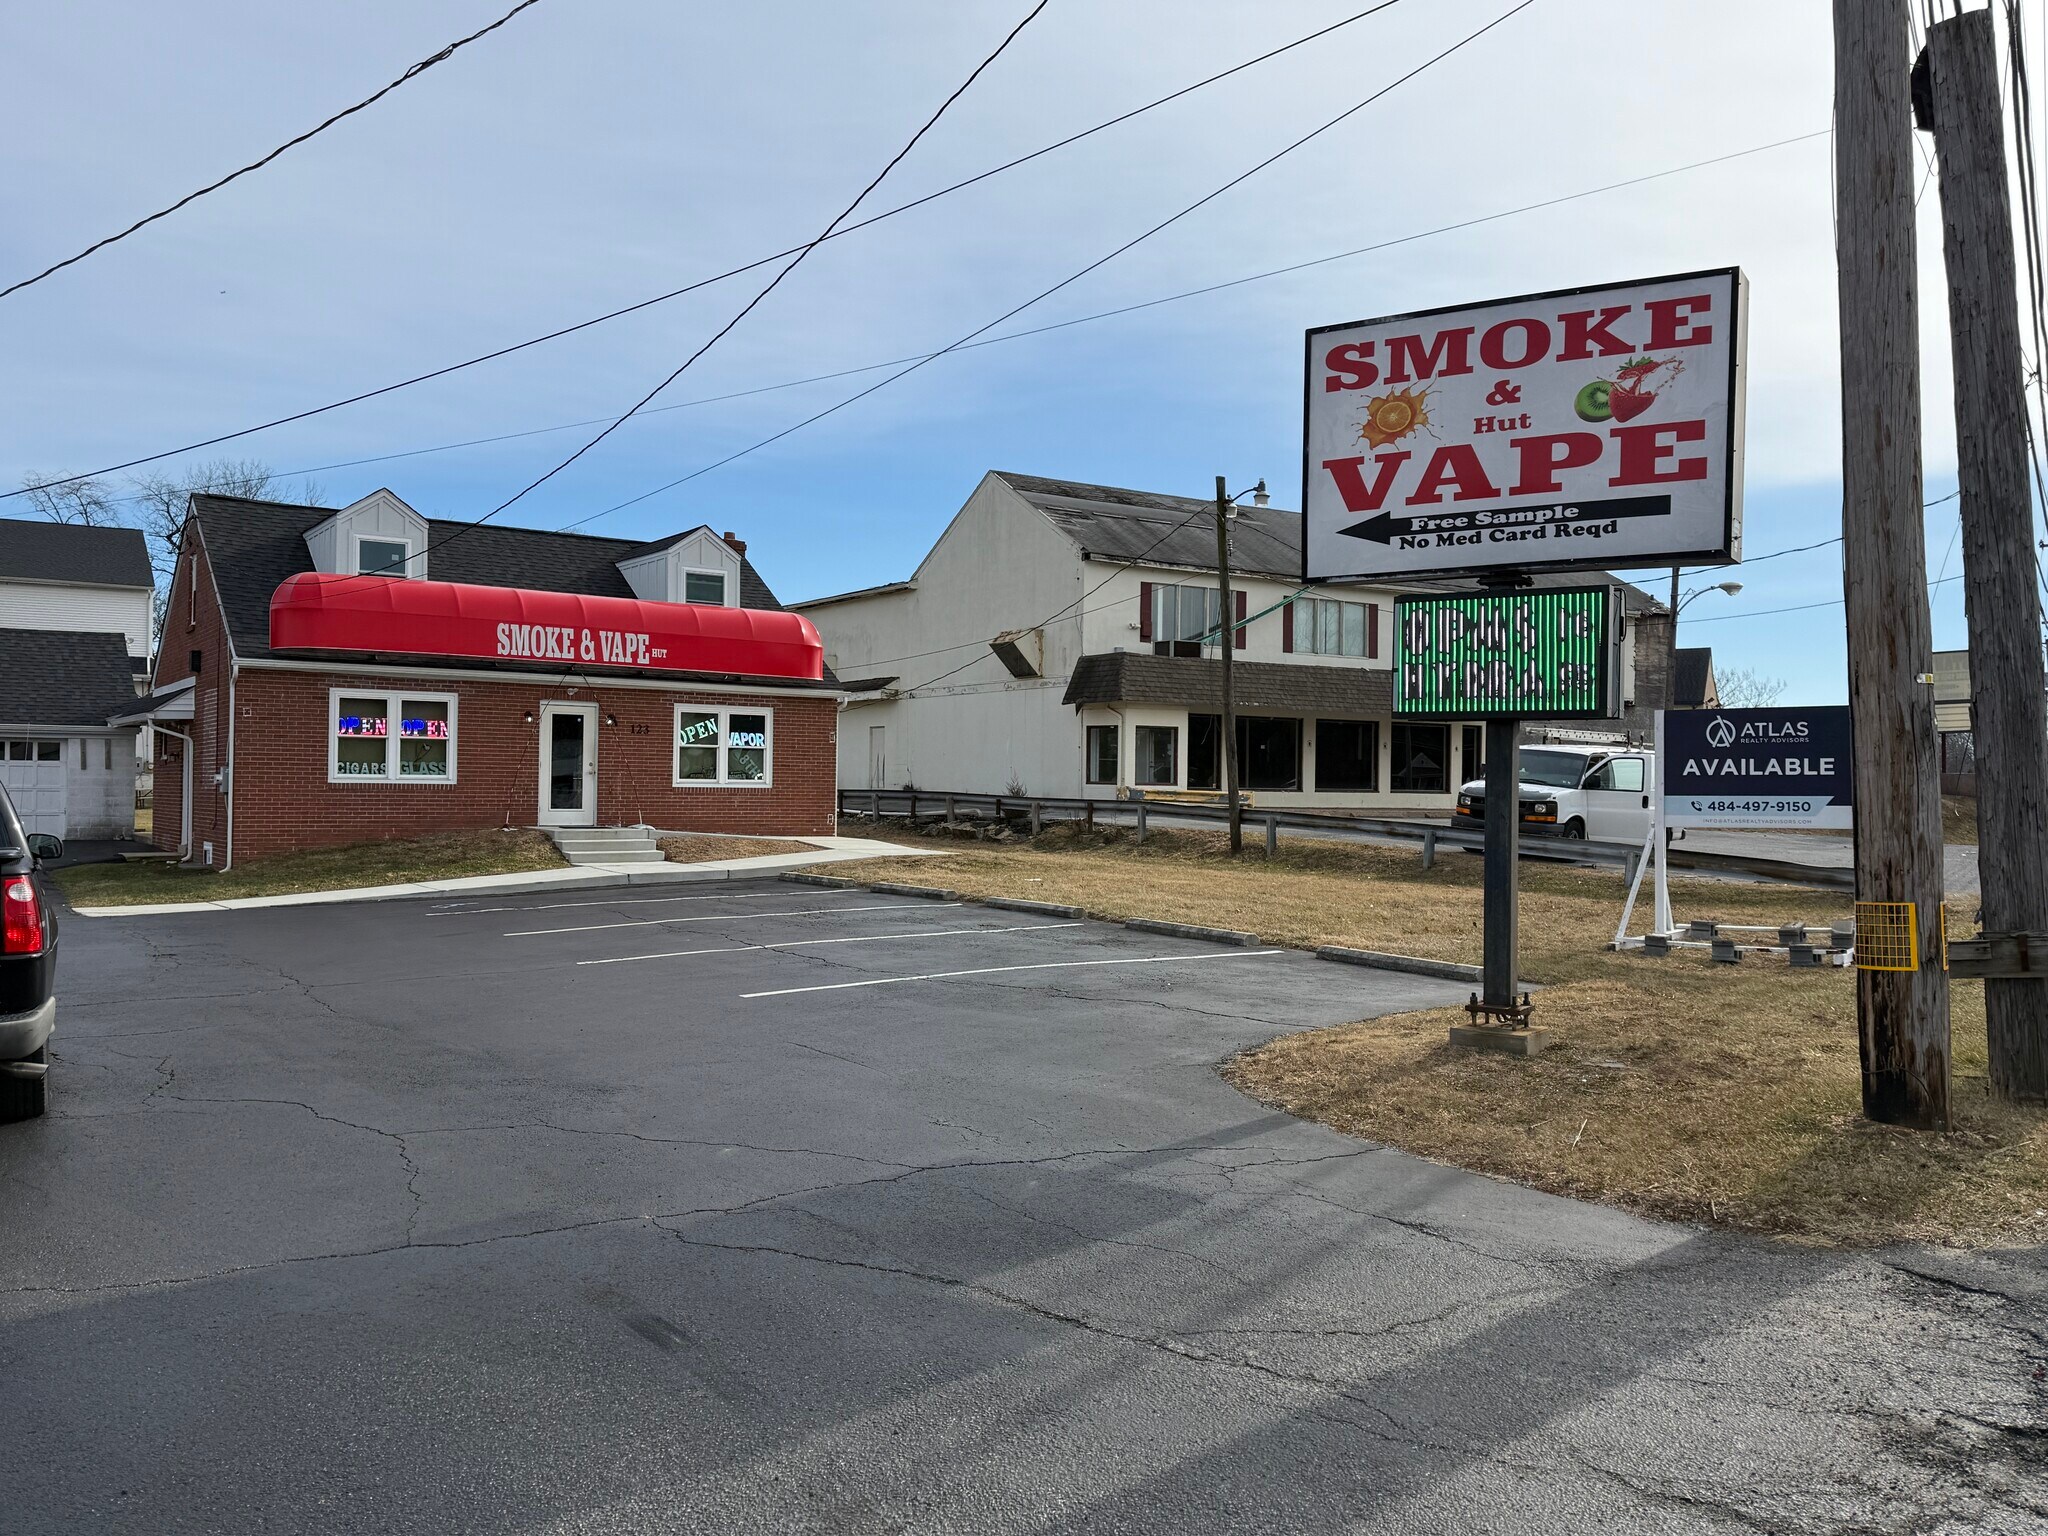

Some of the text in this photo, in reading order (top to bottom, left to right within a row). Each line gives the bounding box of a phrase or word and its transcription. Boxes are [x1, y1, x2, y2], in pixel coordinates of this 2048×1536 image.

[1325, 294, 1713, 393] SMOKE
[1485, 380, 1521, 406] &
[1473, 412, 1532, 434] Hut
[1322, 419, 1708, 513] VAPE
[1410, 504, 1580, 532] Free Sample
[1399, 519, 1618, 550] No Med Card Reqd
[496, 622, 668, 664] SMOKE & VAPE HUT
[338, 716, 387, 736] OPEN
[400, 718, 448, 738] OPEN
[630, 724, 650, 735] 123
[680, 718, 718, 746] OPEN
[1740, 721, 1810, 737] ATLAS
[337, 761, 387, 775] CIGARS
[400, 760, 447, 775] GLASS
[1682, 757, 1836, 776] AVAILABLE
[1707, 801, 1812, 812] 484-497-9150
